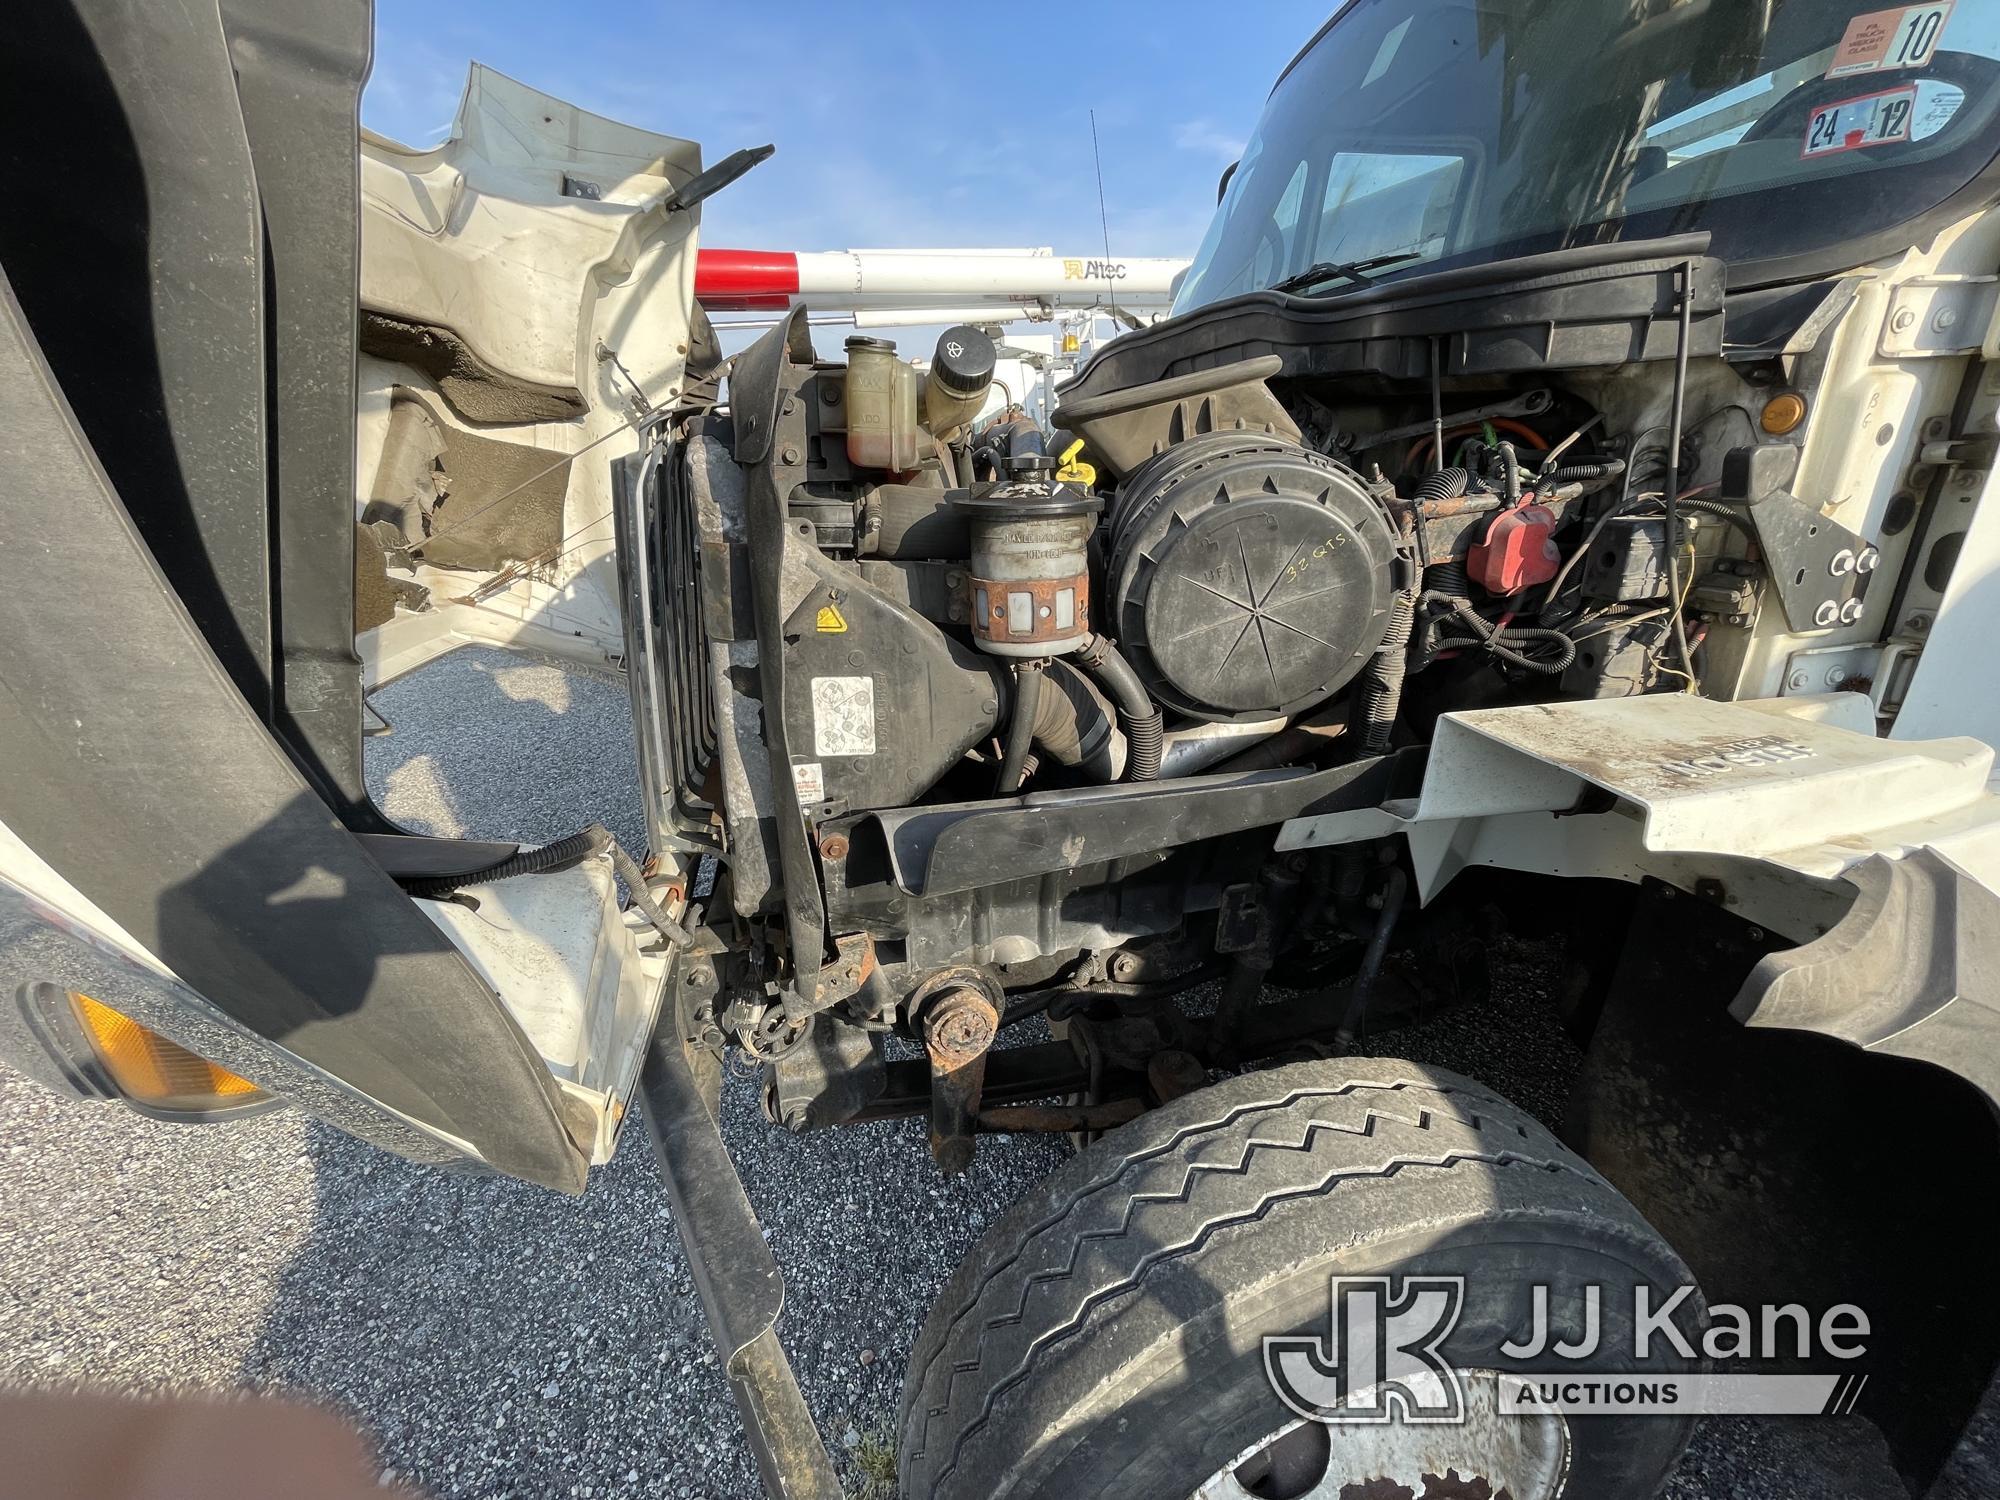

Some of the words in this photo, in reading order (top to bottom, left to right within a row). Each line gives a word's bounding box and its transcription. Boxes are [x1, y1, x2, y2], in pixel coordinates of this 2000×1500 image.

[1848, 36, 1885, 47] WEIGHT
[1856, 29, 1886, 39] TRUCK
[1896, 11, 1942, 62] 10
[1848, 44, 1879, 55] CLASS
[1809, 109, 1840, 149] 24
[1877, 99, 1910, 138] 12
[1084, 260, 1126, 280] Altec
[1286, 558, 1309, 584] 32
[1658, 755, 1733, 778] NO
[1722, 744, 1818, 767] STEP
